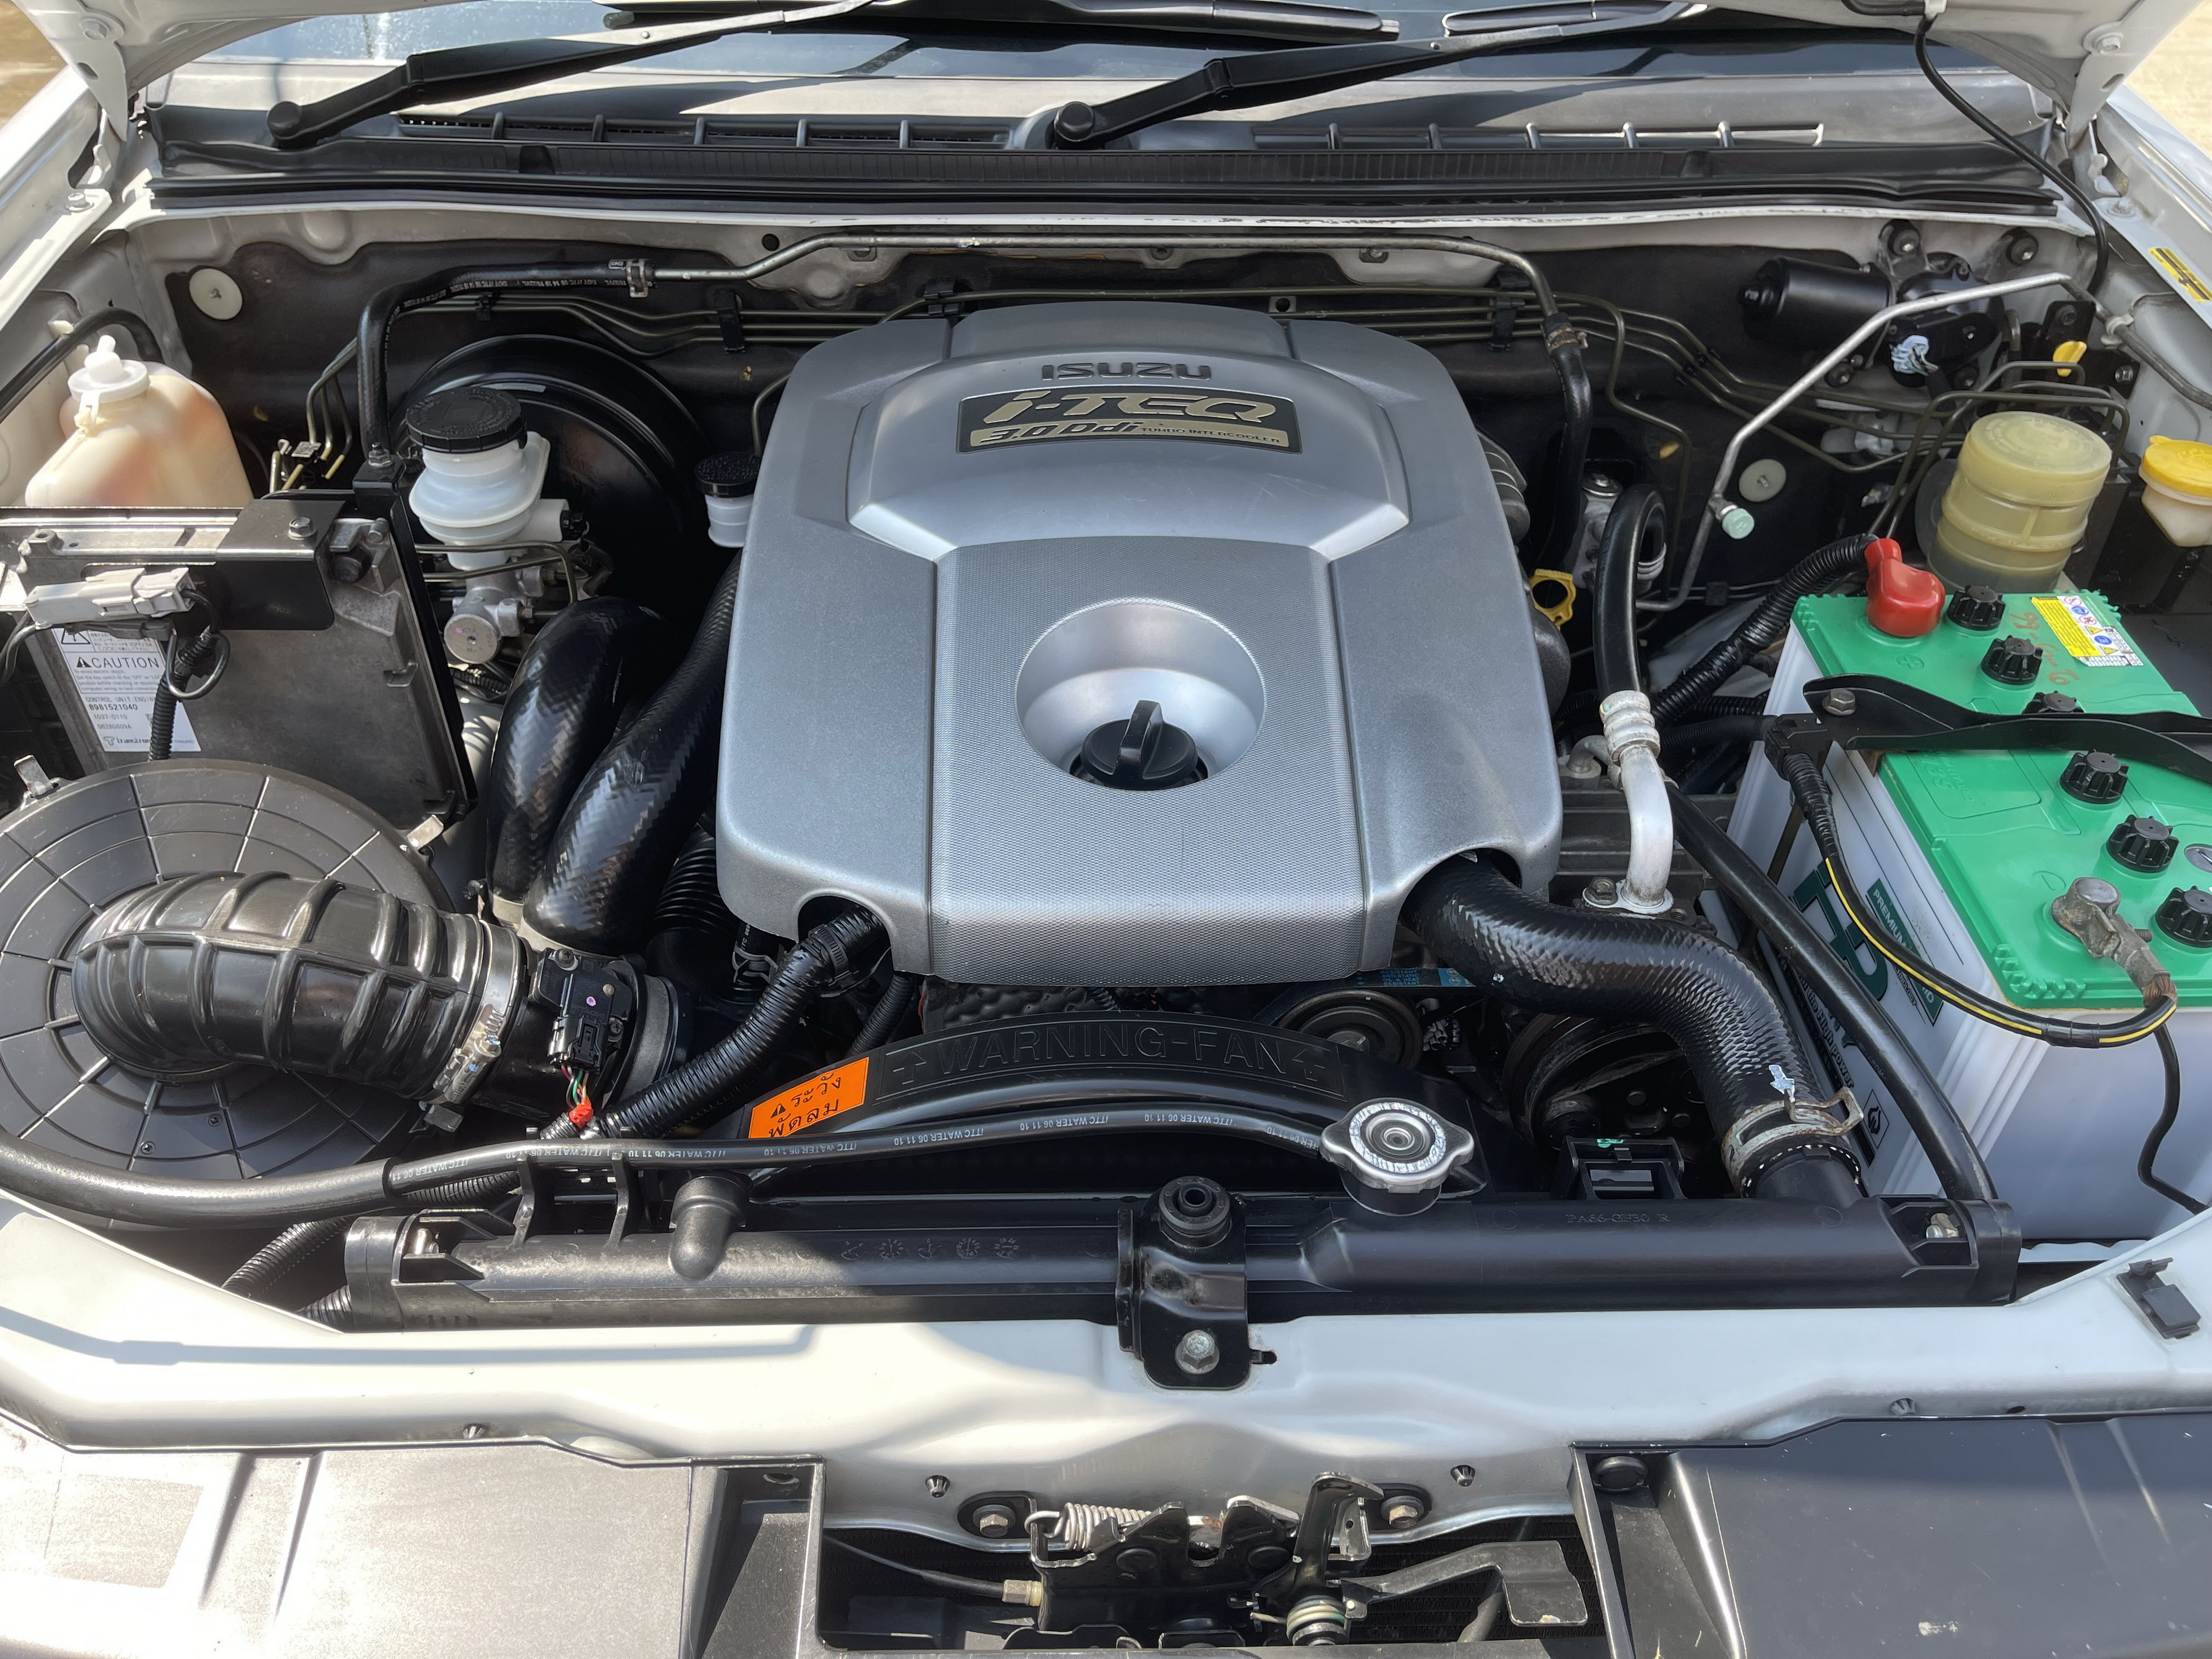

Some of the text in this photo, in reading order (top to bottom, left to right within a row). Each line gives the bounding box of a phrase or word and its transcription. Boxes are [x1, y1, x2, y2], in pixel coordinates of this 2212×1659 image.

[1041, 362, 1212, 381] ISUZU
[983, 390, 1277, 424] i-TEQ
[979, 424, 1059, 444] 3.0
[1058, 421, 1146, 437] Ddi
[1189, 429, 1280, 443] INTERCOOLER
[91, 657, 160, 668] CAUTION
[937, 1023, 1286, 1075] WARNING-FAN
[791, 1072, 842, 1107] ระวัง
[768, 1098, 839, 1138] พัดลม
[1056, 1116, 1088, 1128] WATER
[1180, 1114, 1212, 1124] WATER
[1020, 1123, 1030, 1131] 10
[1032, 1121, 1042, 1130] 11
[1044, 1120, 1053, 1128] 06
[907, 1136, 916, 1144] 11
[918, 1134, 928, 1143] 06
[930, 1130, 963, 1142] WATER
[894, 1138, 904, 1146] 10
[544, 1148, 578, 1156] WATER
[789, 1146, 800, 1155] 06
[802, 1144, 835, 1155] WATER
[416, 1161, 449, 1176] WATER
